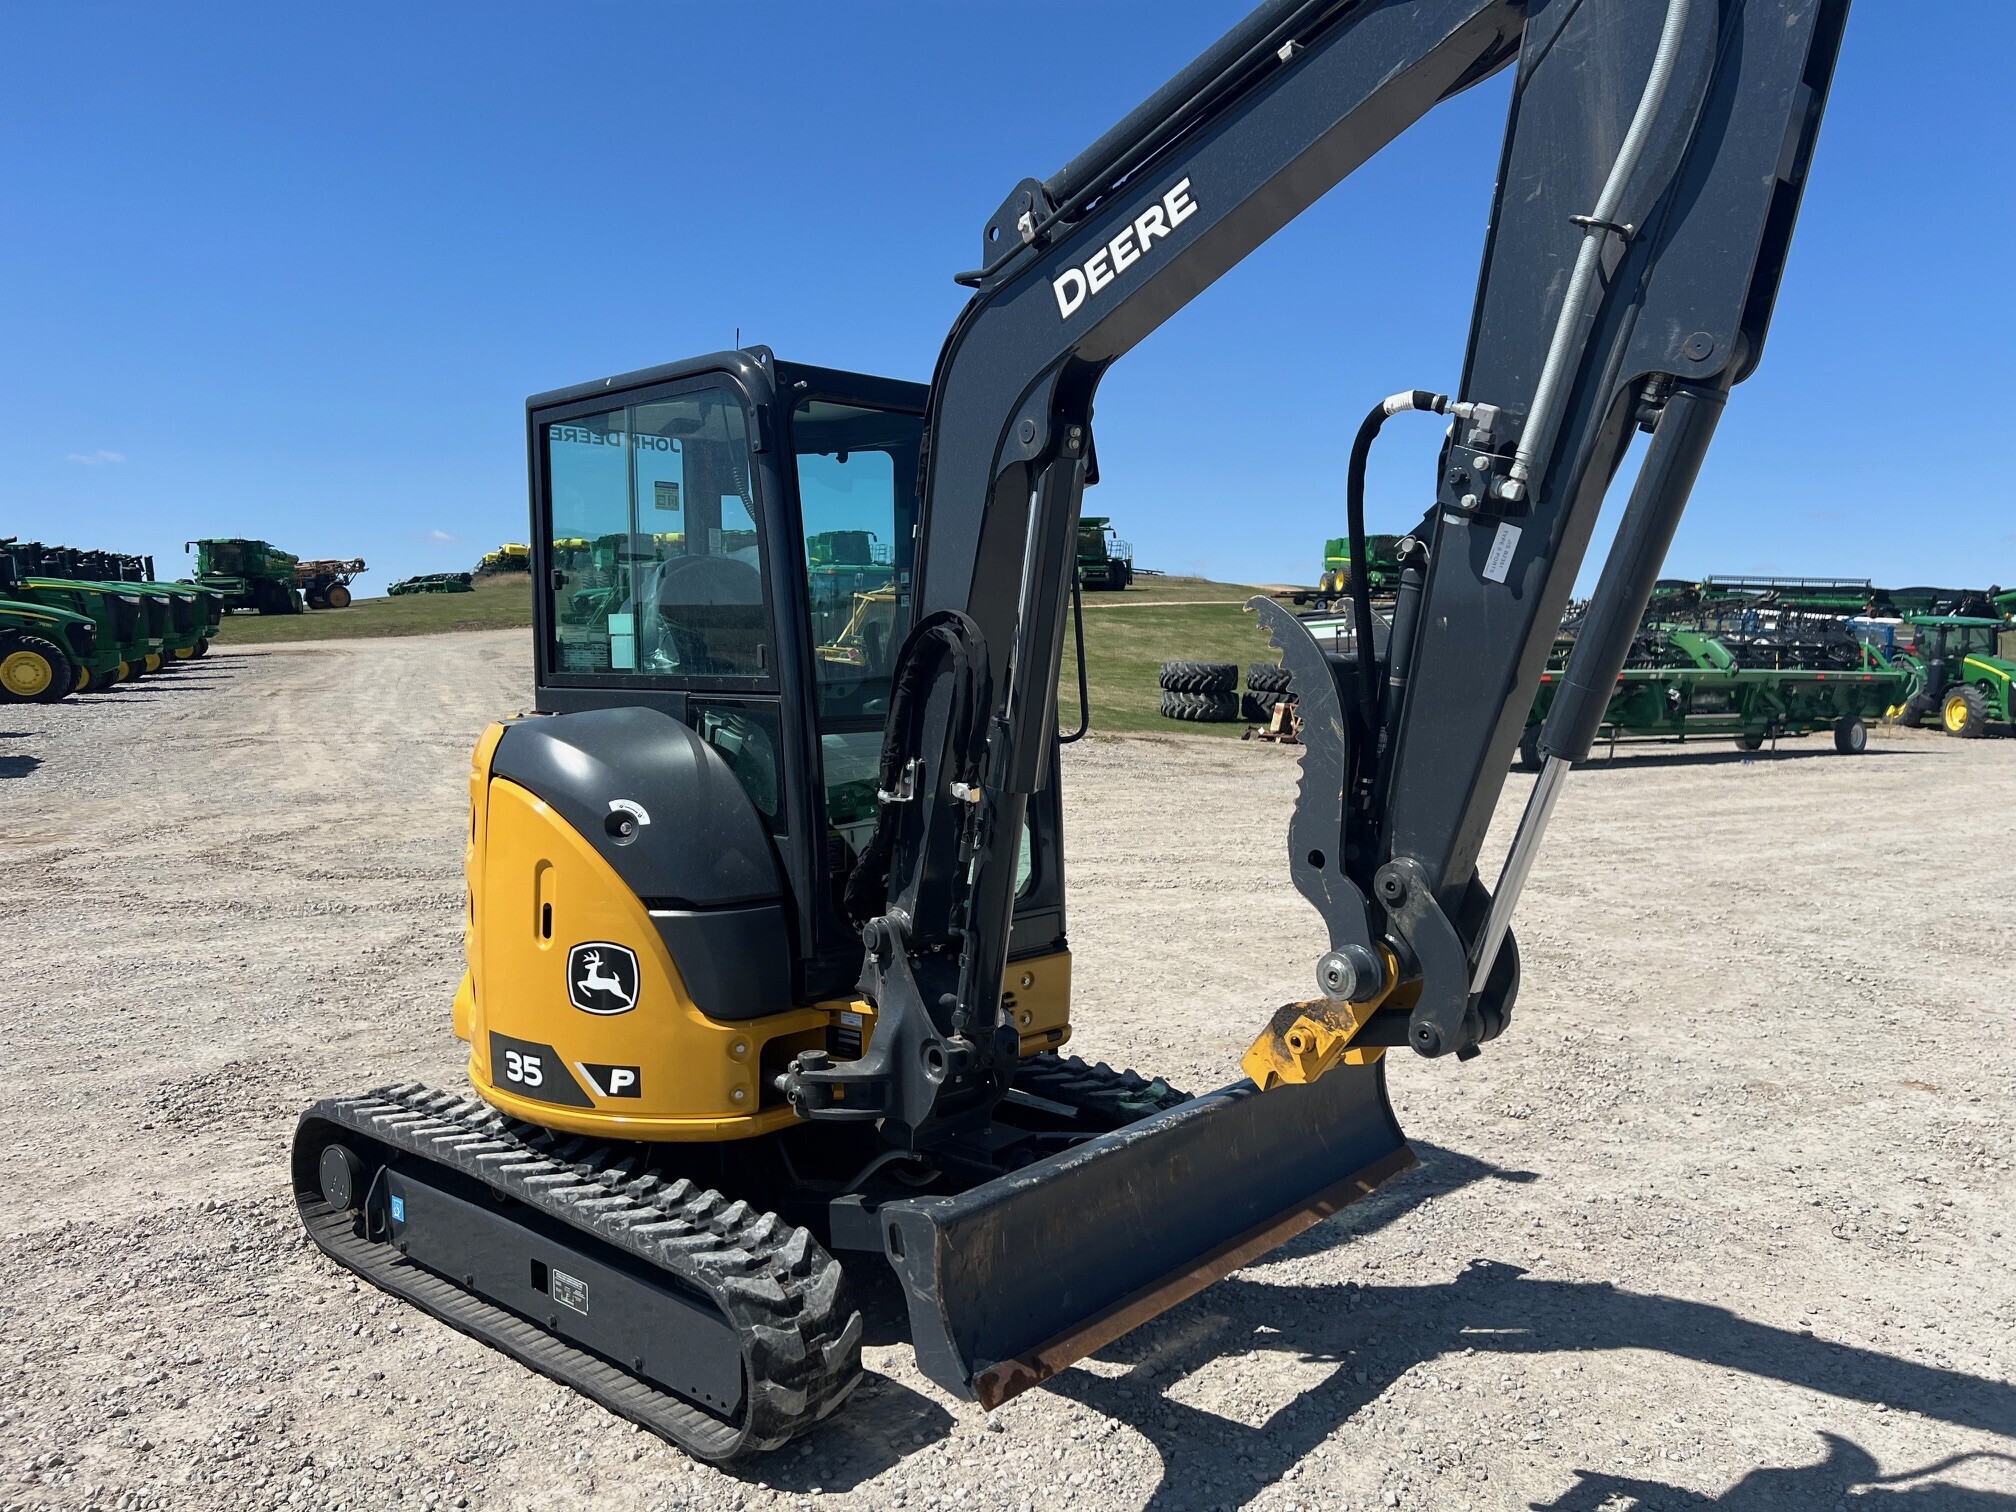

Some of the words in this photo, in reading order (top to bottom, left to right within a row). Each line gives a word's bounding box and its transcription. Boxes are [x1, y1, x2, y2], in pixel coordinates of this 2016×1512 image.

[1053, 177, 1198, 319] DEERE
[1490, 553, 1500, 573] PORTS
[505, 1050, 543, 1087] 35
[609, 1068, 635, 1094] P
